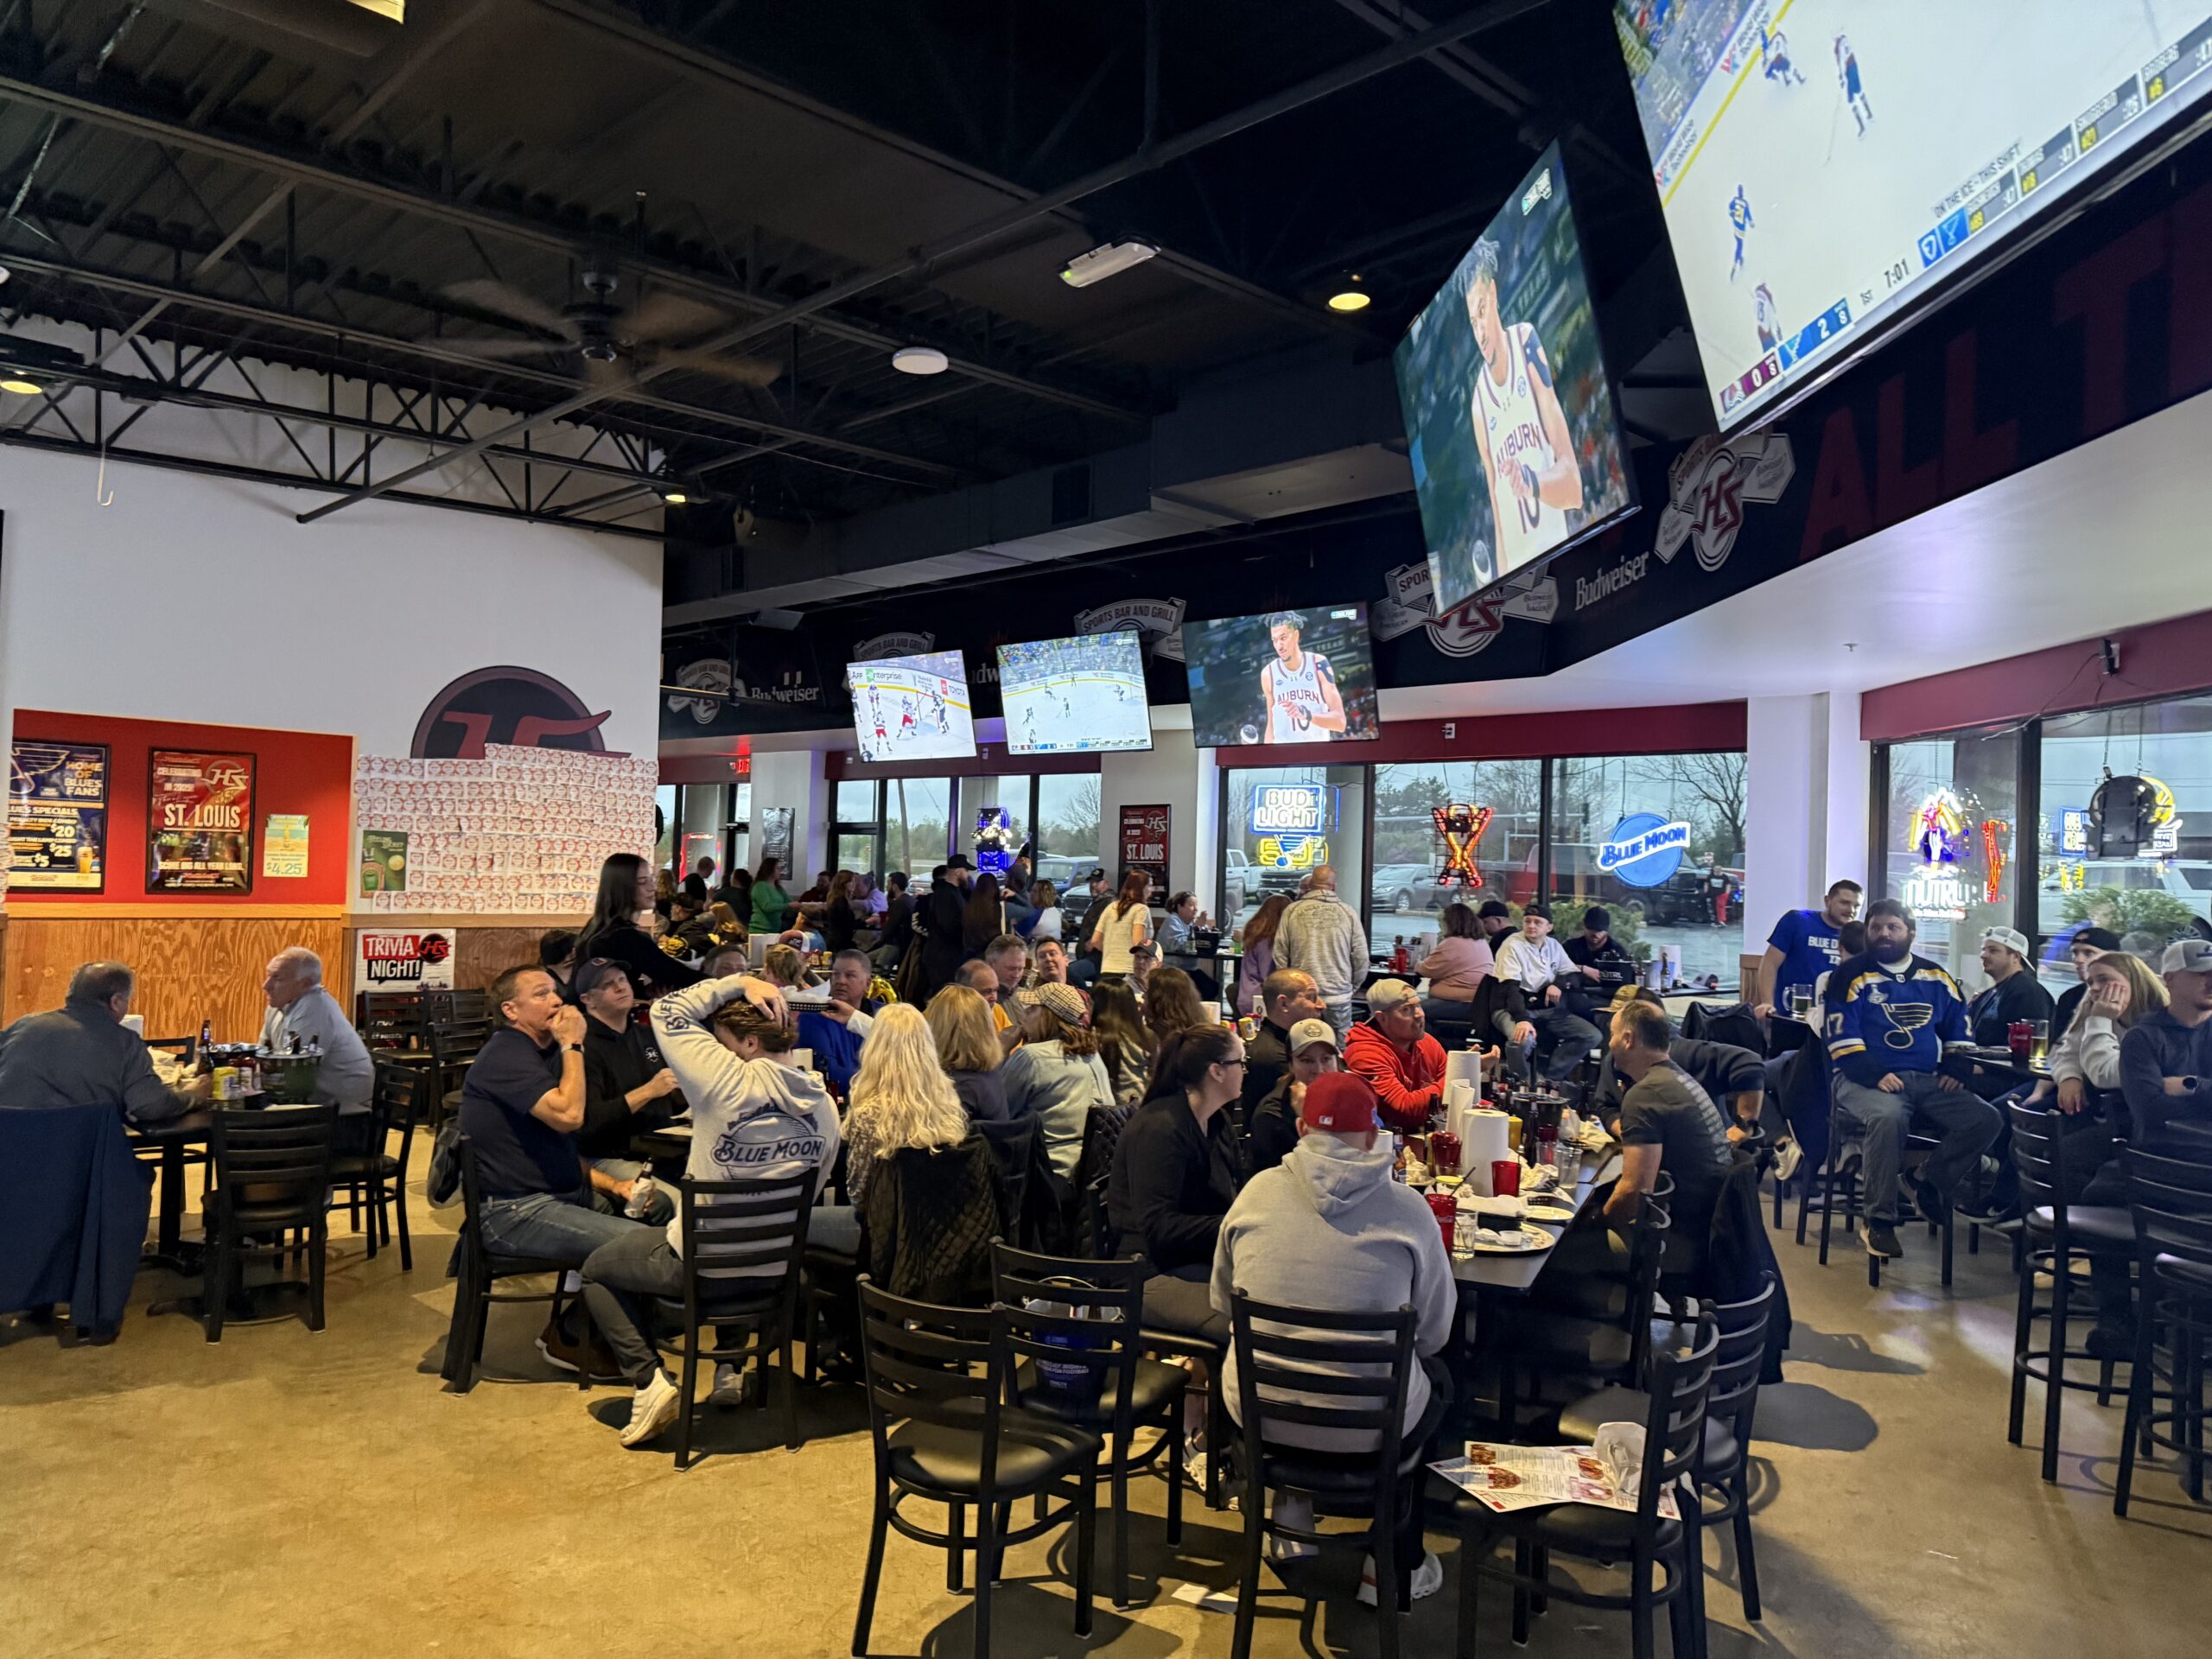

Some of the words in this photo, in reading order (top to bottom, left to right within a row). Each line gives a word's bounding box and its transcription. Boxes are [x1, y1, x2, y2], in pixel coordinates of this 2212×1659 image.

[1884, 257, 1910, 288] 7:01
[1817, 318, 1830, 340] 2
[1751, 368, 1763, 387] 0
[1798, 327, 2020, 562] ALL
[1399, 569, 1430, 593] SPOR
[1574, 550, 1649, 612] Budweiser
[1114, 606, 1131, 619] BAR
[1132, 605, 1151, 616] AND
[1151, 606, 1174, 622] GRILL
[1277, 689, 1320, 705] AUBURN
[65, 761, 103, 771] HOME
[74, 770, 93, 779] OF
[64, 778, 102, 788] BLUES
[66, 786, 100, 797] FANS
[1266, 788, 1308, 807] BUD
[164, 803, 189, 827] ST.
[194, 804, 241, 829] LOUIS
[1257, 806, 1318, 827] LIGHT
[50, 823, 75, 838] $20
[49, 842, 73, 857] $25
[1126, 844, 1139, 860] ST.
[1140, 843, 1164, 861] LOUIS
[1600, 841, 1643, 867] BLUE
[1644, 827, 1686, 852] MOON
[34, 853, 49, 868] $5
[266, 861, 302, 875] $4.25
[365, 938, 416, 957] TRIVIA
[1808, 936, 1831, 948] BLUE
[370, 959, 421, 978] NIGHT!
[1826, 1012, 1844, 1037] 17
[714, 1139, 772, 1163] BLUE
[772, 1141, 823, 1160] MOON
